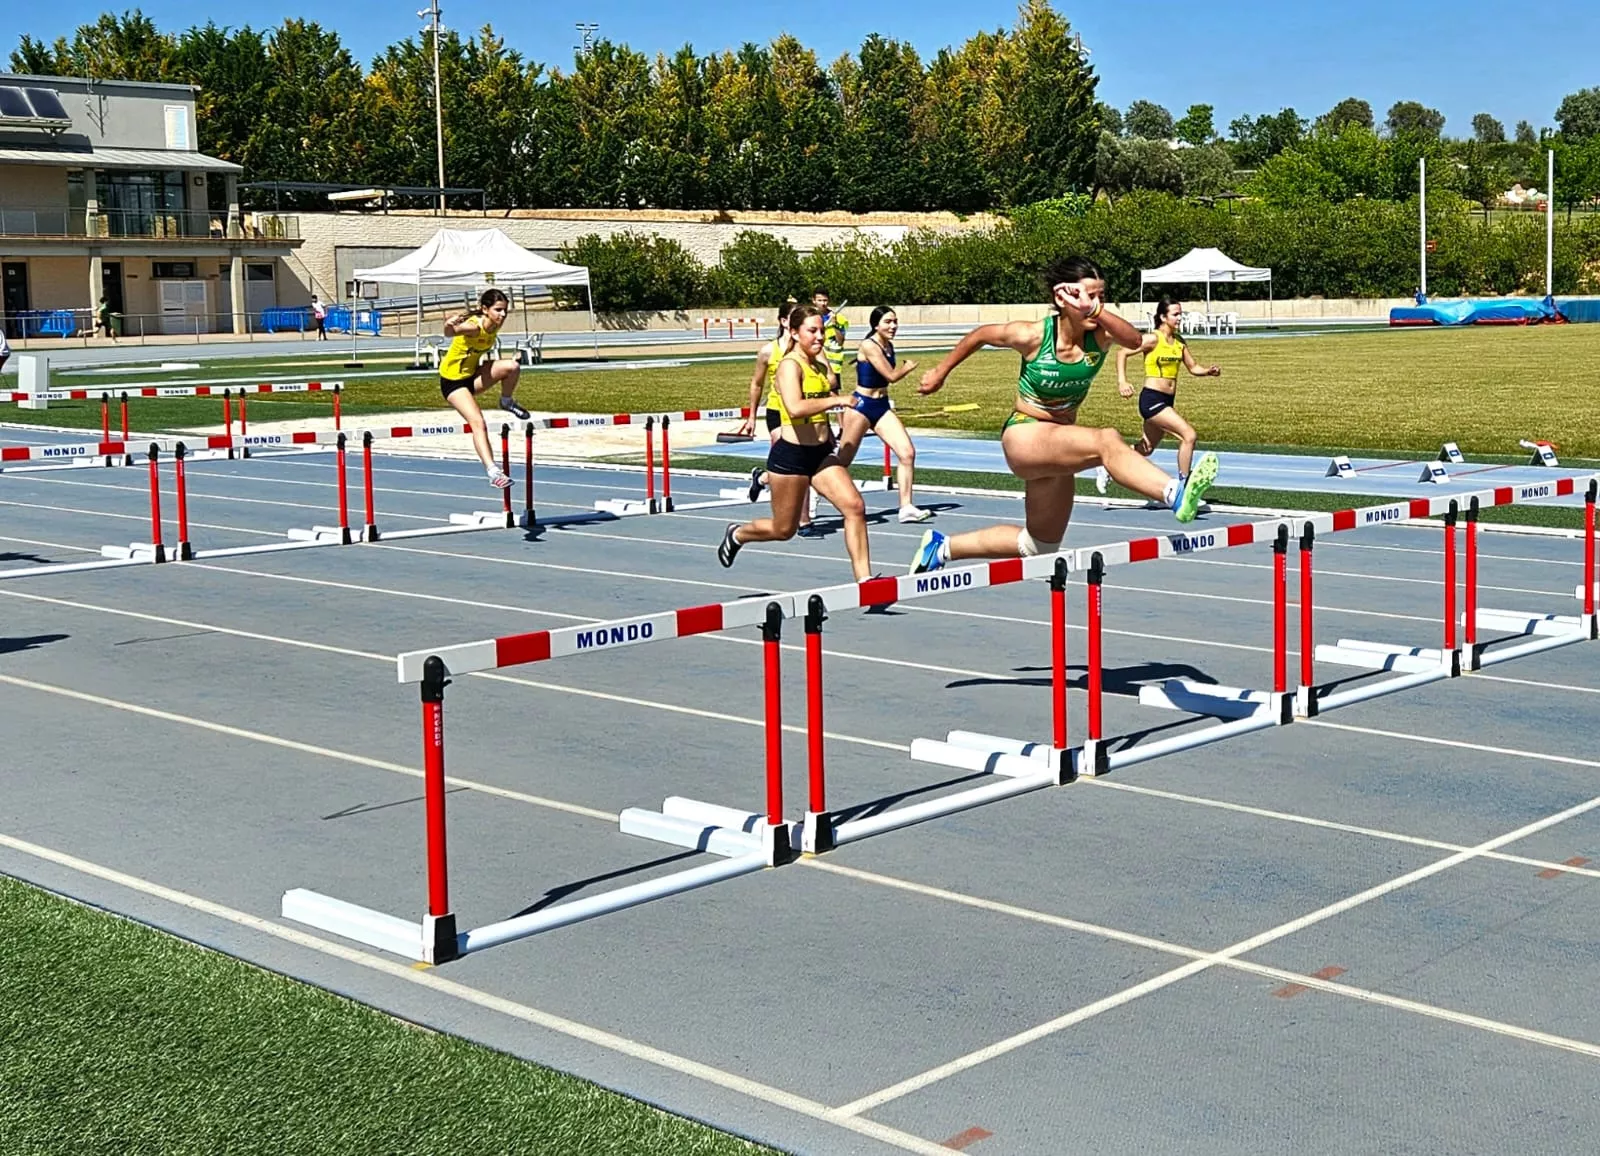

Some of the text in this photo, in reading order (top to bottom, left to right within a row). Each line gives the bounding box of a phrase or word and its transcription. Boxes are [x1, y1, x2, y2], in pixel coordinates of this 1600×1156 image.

[1040, 378, 1092, 389] Huesc
[422, 426, 454, 434] MONDO
[245, 436, 280, 444] MONDO
[44, 447, 85, 457] MONDO
[1522, 486, 1548, 498] MONDO
[1366, 508, 1400, 522] MONDO
[1172, 534, 1214, 552] MONDO
[916, 572, 972, 593] MONDO
[577, 623, 652, 648] MONDO
